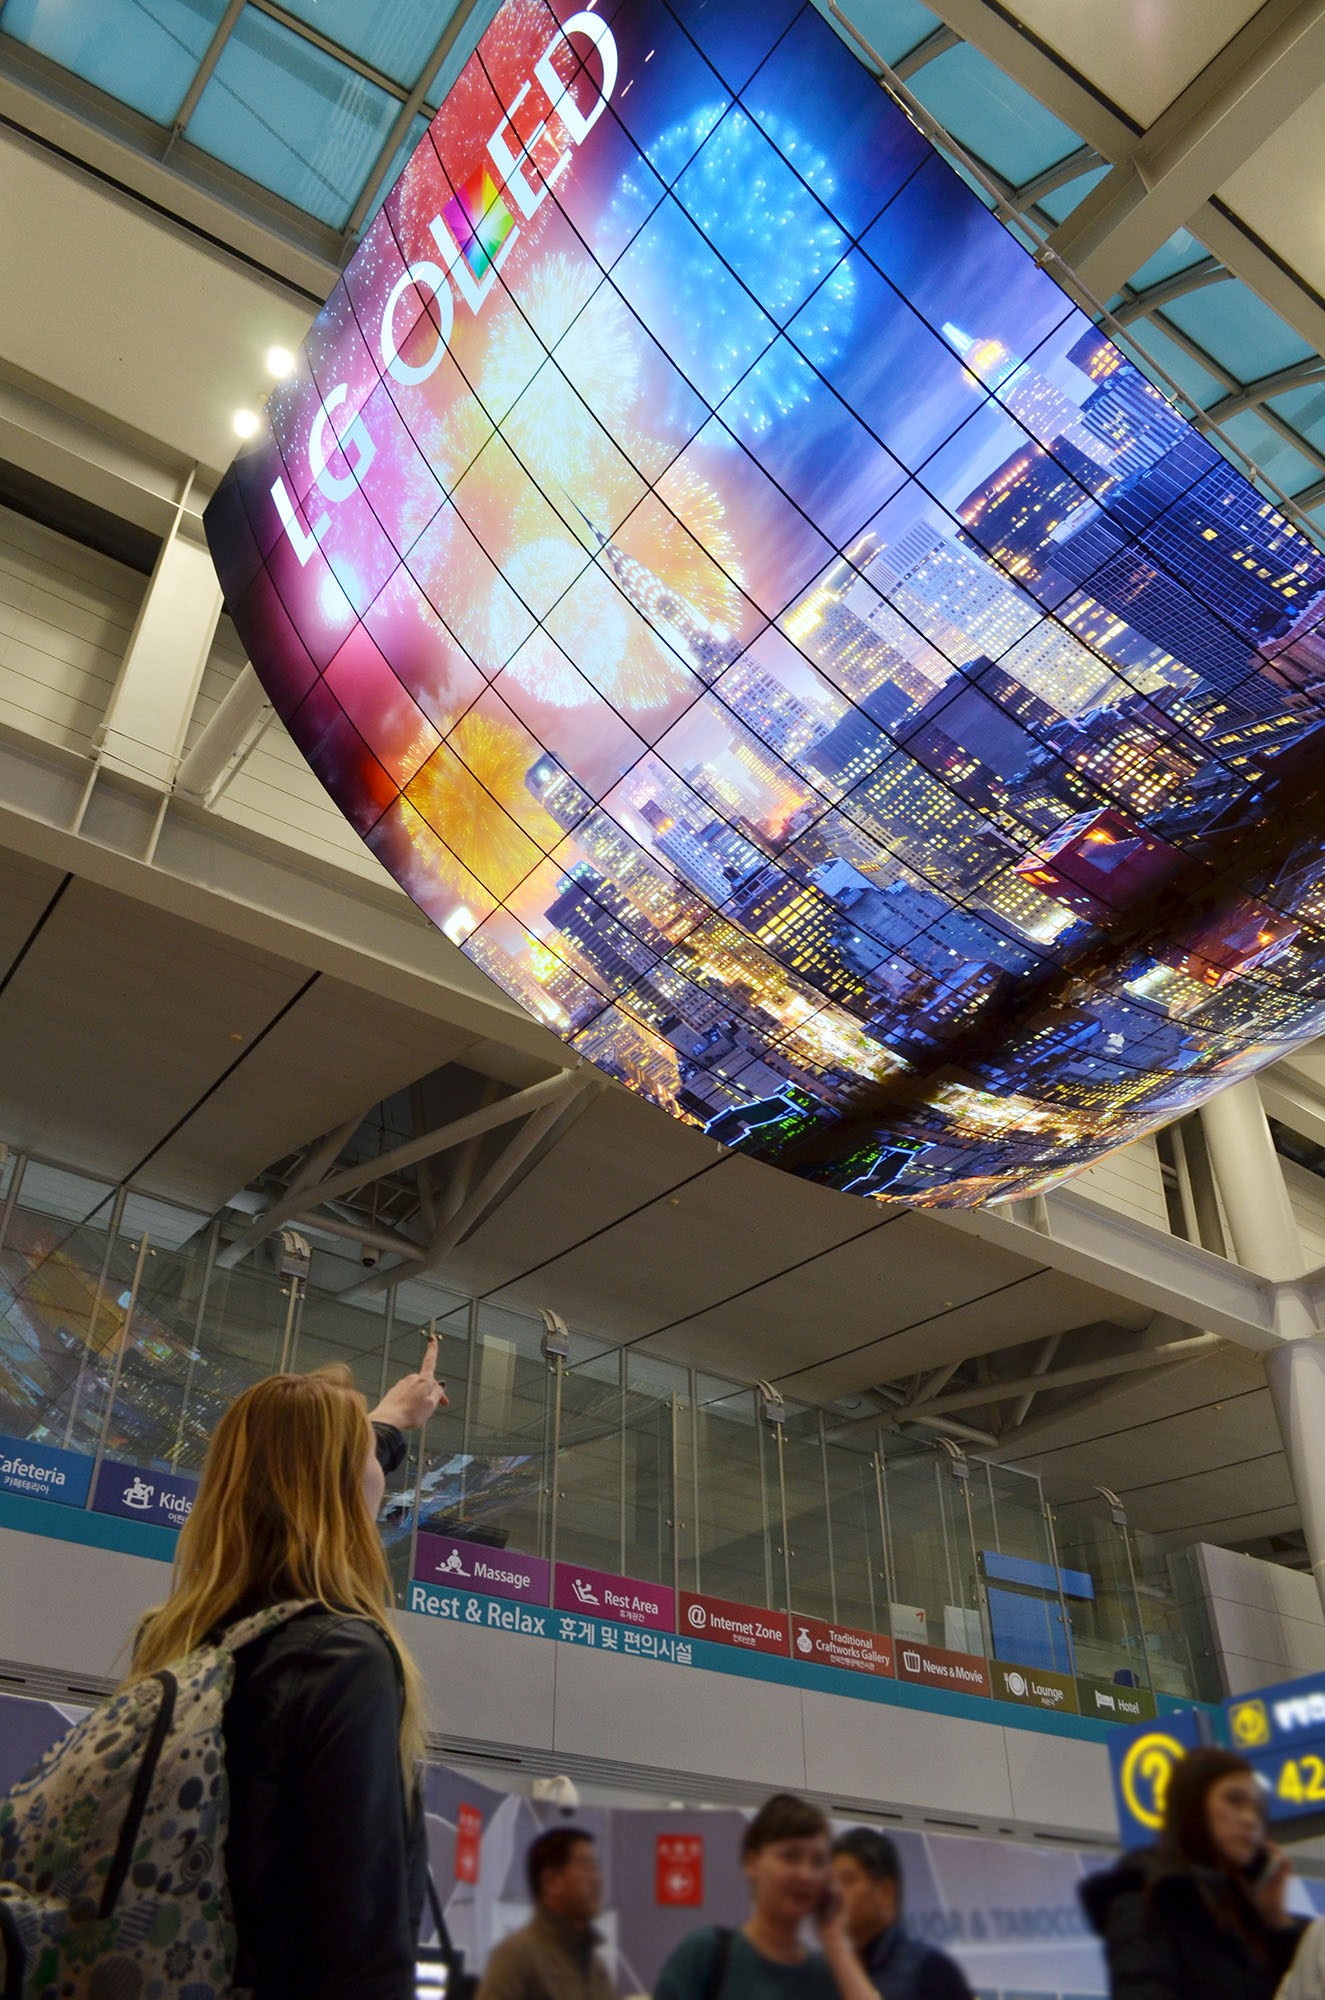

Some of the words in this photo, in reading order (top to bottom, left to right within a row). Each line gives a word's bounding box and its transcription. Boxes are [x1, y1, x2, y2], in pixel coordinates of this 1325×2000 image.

[270, 382, 377, 568] LG
[380, 10, 619, 386] OLED
[3, 1475, 49, 1495] 카페테리아
[159, 1491, 193, 1514] Kids
[474, 1561, 531, 1589] Massage
[411, 1586, 460, 1620] Rest
[464, 1598, 482, 1624] &
[487, 1602, 546, 1636] Relax
[604, 1590, 631, 1610] Rest
[631, 1596, 659, 1615] Area
[710, 1613, 755, 1636] Internet
[755, 1623, 783, 1641] Zone
[828, 1630, 873, 1649] Traditional
[559, 1617, 596, 1646] 휴게
[601, 1625, 618, 1651] 및
[623, 1630, 692, 1665] 편의시설
[815, 1639, 861, 1659] Craftworks
[861, 1649, 890, 1667] Gallery
[922, 1659, 948, 1677] News
[949, 1666, 956, 1678] &
[955, 1665, 984, 1684] Movie
[1031, 1681, 1064, 1701] Lounge
[1117, 1698, 1140, 1714] Hotel
